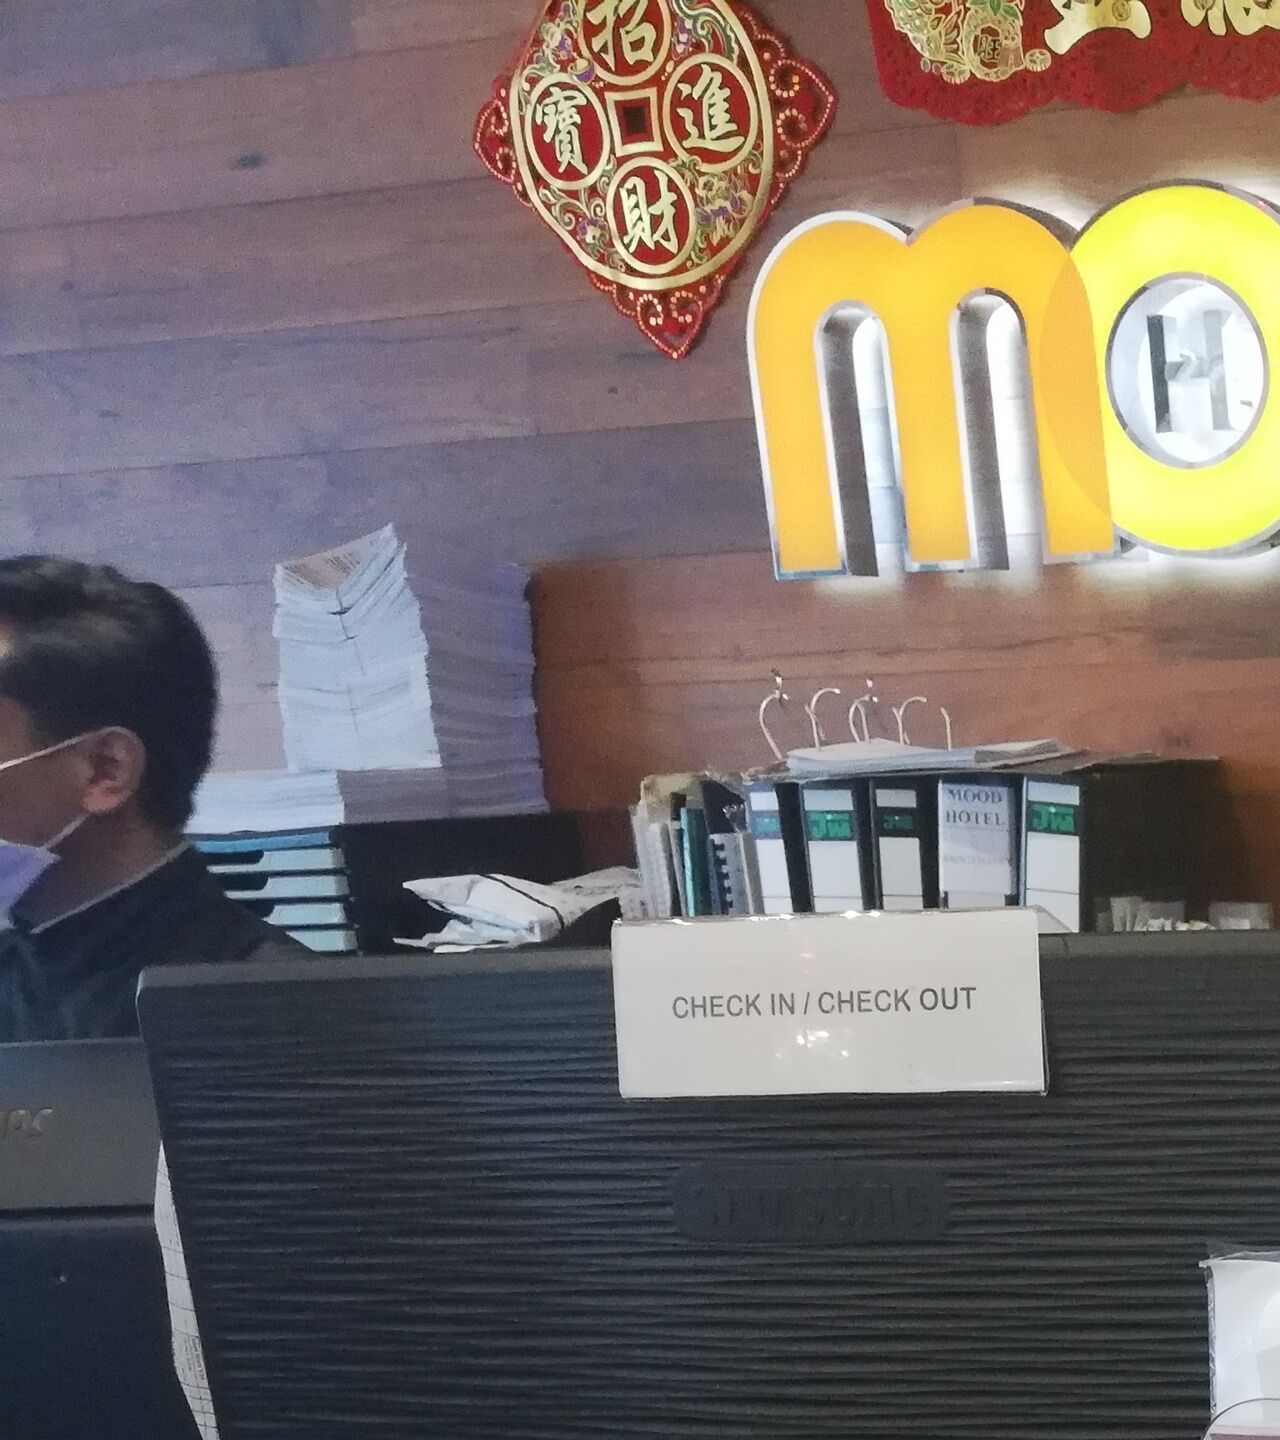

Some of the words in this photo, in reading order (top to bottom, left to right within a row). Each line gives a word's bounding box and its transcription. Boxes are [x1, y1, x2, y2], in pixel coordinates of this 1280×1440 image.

[534, 87, 590, 174] 寶
[676, 64, 746, 152] 進
[620, 168, 680, 254] 財
[945, 809, 1005, 827] HOTEL
[672, 992, 761, 1019] CHECK
[770, 991, 796, 1016] IN
[817, 987, 912, 1014] CHECK
[918, 985, 977, 1011] OUT
